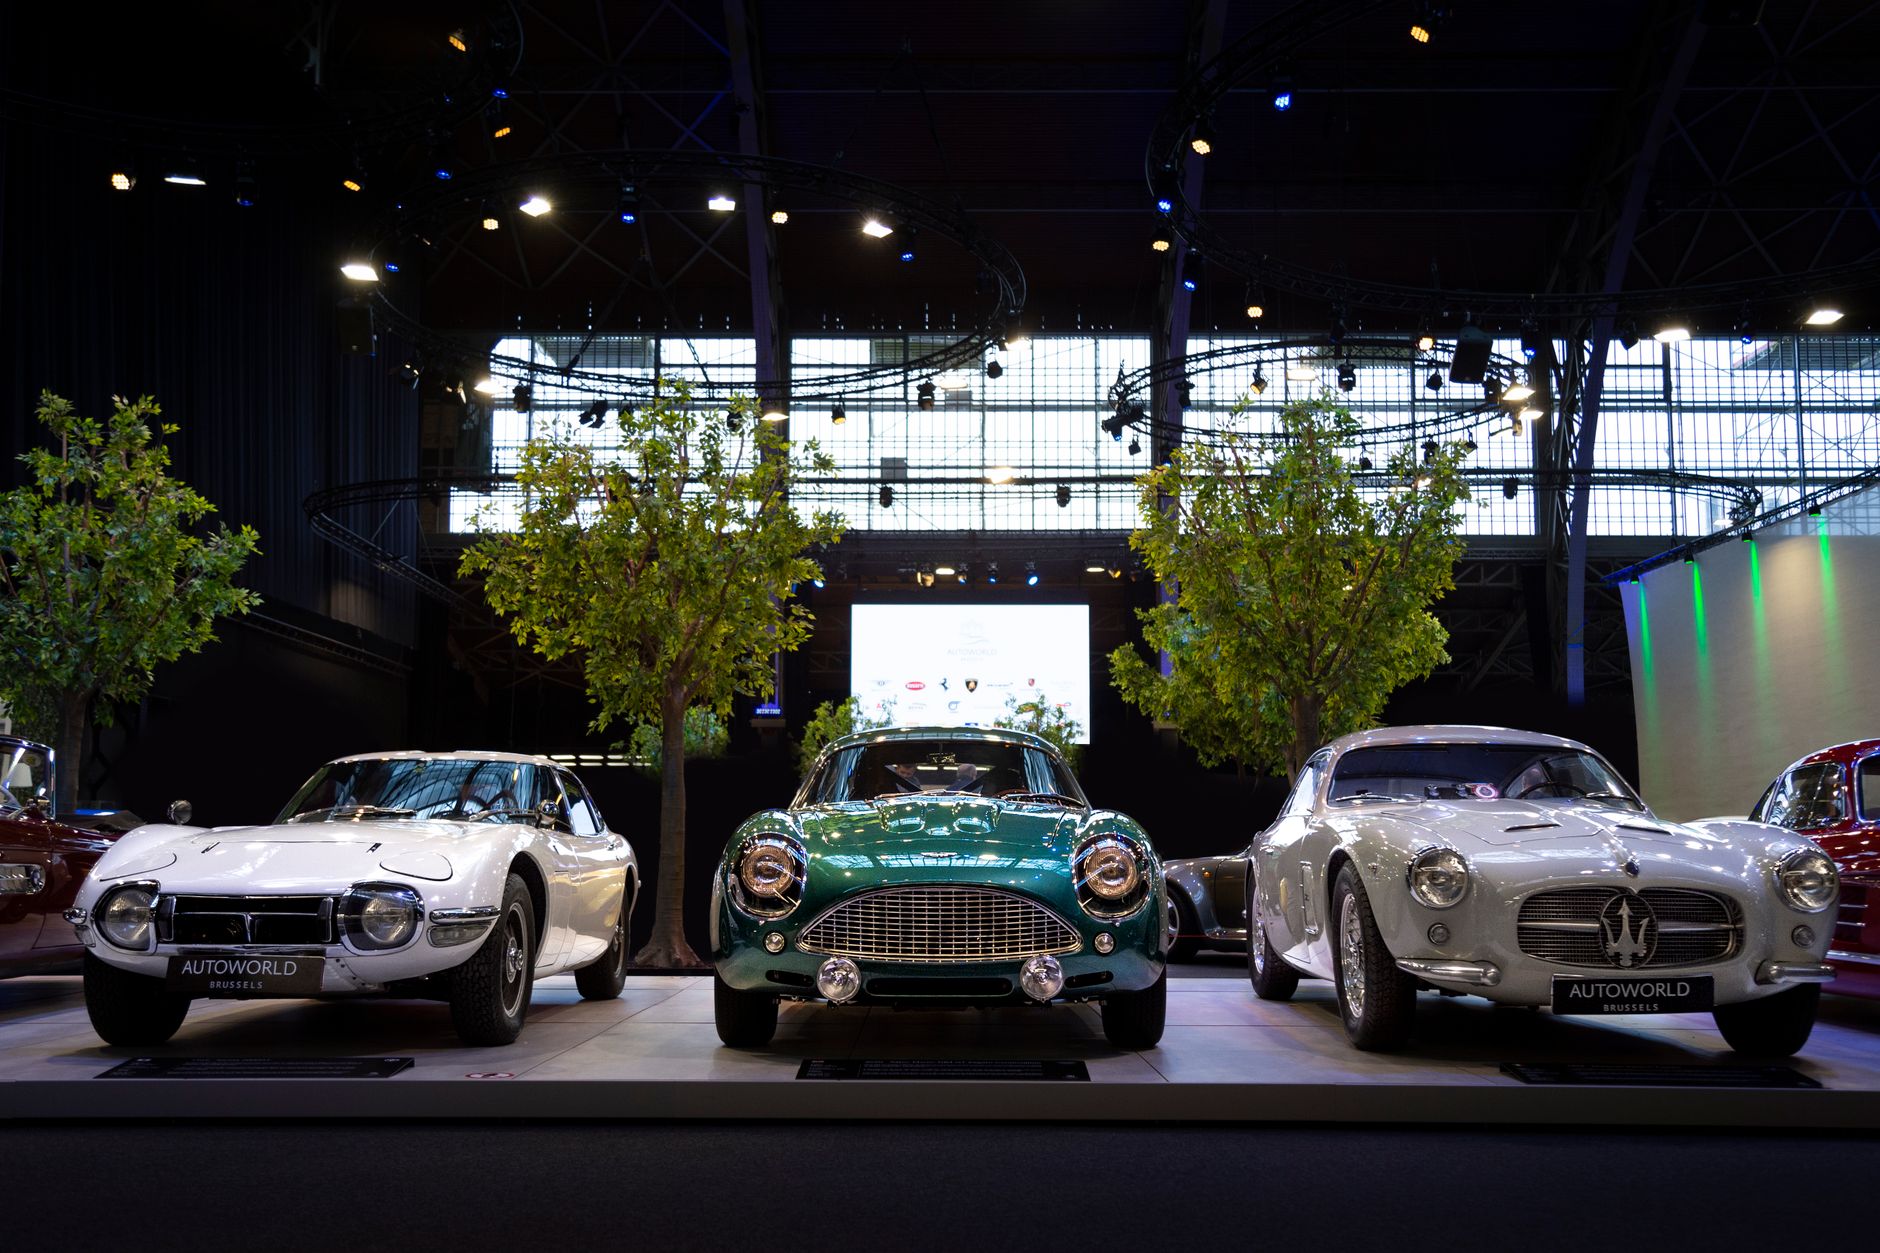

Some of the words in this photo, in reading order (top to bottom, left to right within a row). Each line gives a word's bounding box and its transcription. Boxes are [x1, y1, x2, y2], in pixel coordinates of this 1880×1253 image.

[181, 960, 297, 976] AUTOWORLD
[210, 981, 263, 989] BRUSSELS
[1569, 982, 1690, 998] AUTOWORLD
[1603, 1003, 1659, 1012] BRUSSELS
